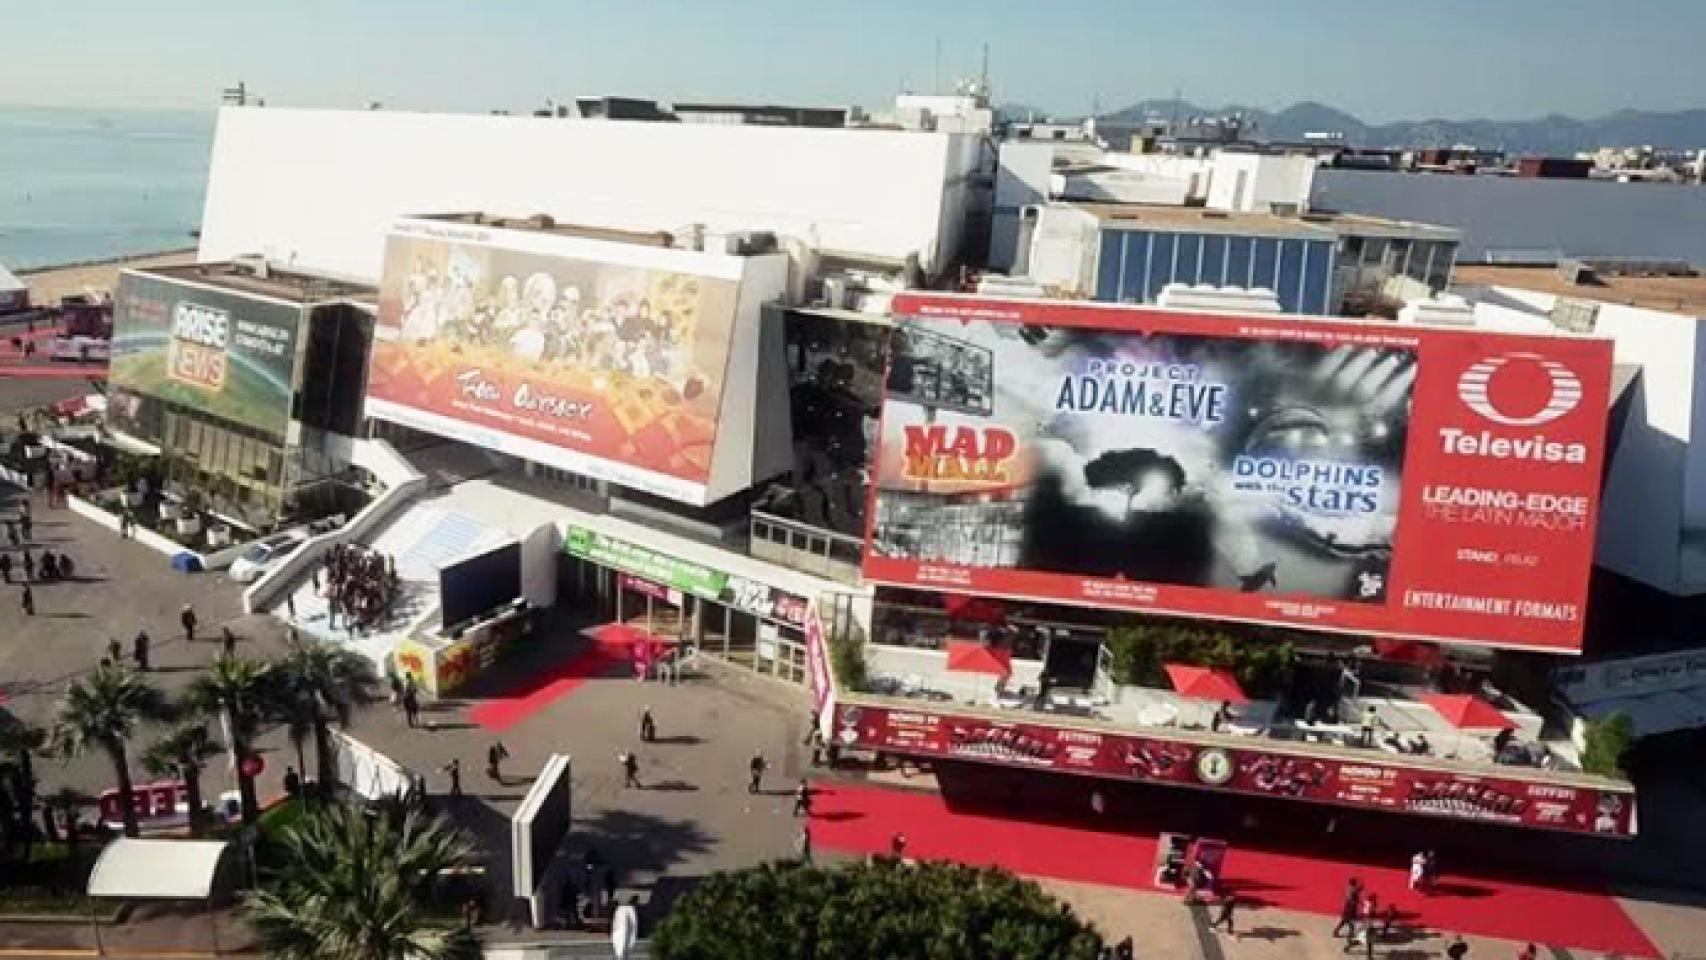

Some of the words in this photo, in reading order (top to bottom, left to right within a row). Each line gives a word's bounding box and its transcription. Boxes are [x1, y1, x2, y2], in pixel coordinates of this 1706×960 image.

[1089, 360, 1199, 380] PROJECT
[1440, 428, 1587, 464] Televisa
[1237, 459, 1381, 487] DOLPHINS
[1287, 485, 1378, 513] stars
[1422, 485, 1589, 516] LEADING-EDGE
[1464, 508, 1513, 526] LATIN
[1518, 511, 1585, 532] MAJOR
[1404, 590, 1512, 616] ENTERTAINMENT
[1514, 600, 1577, 621] FORMATS
